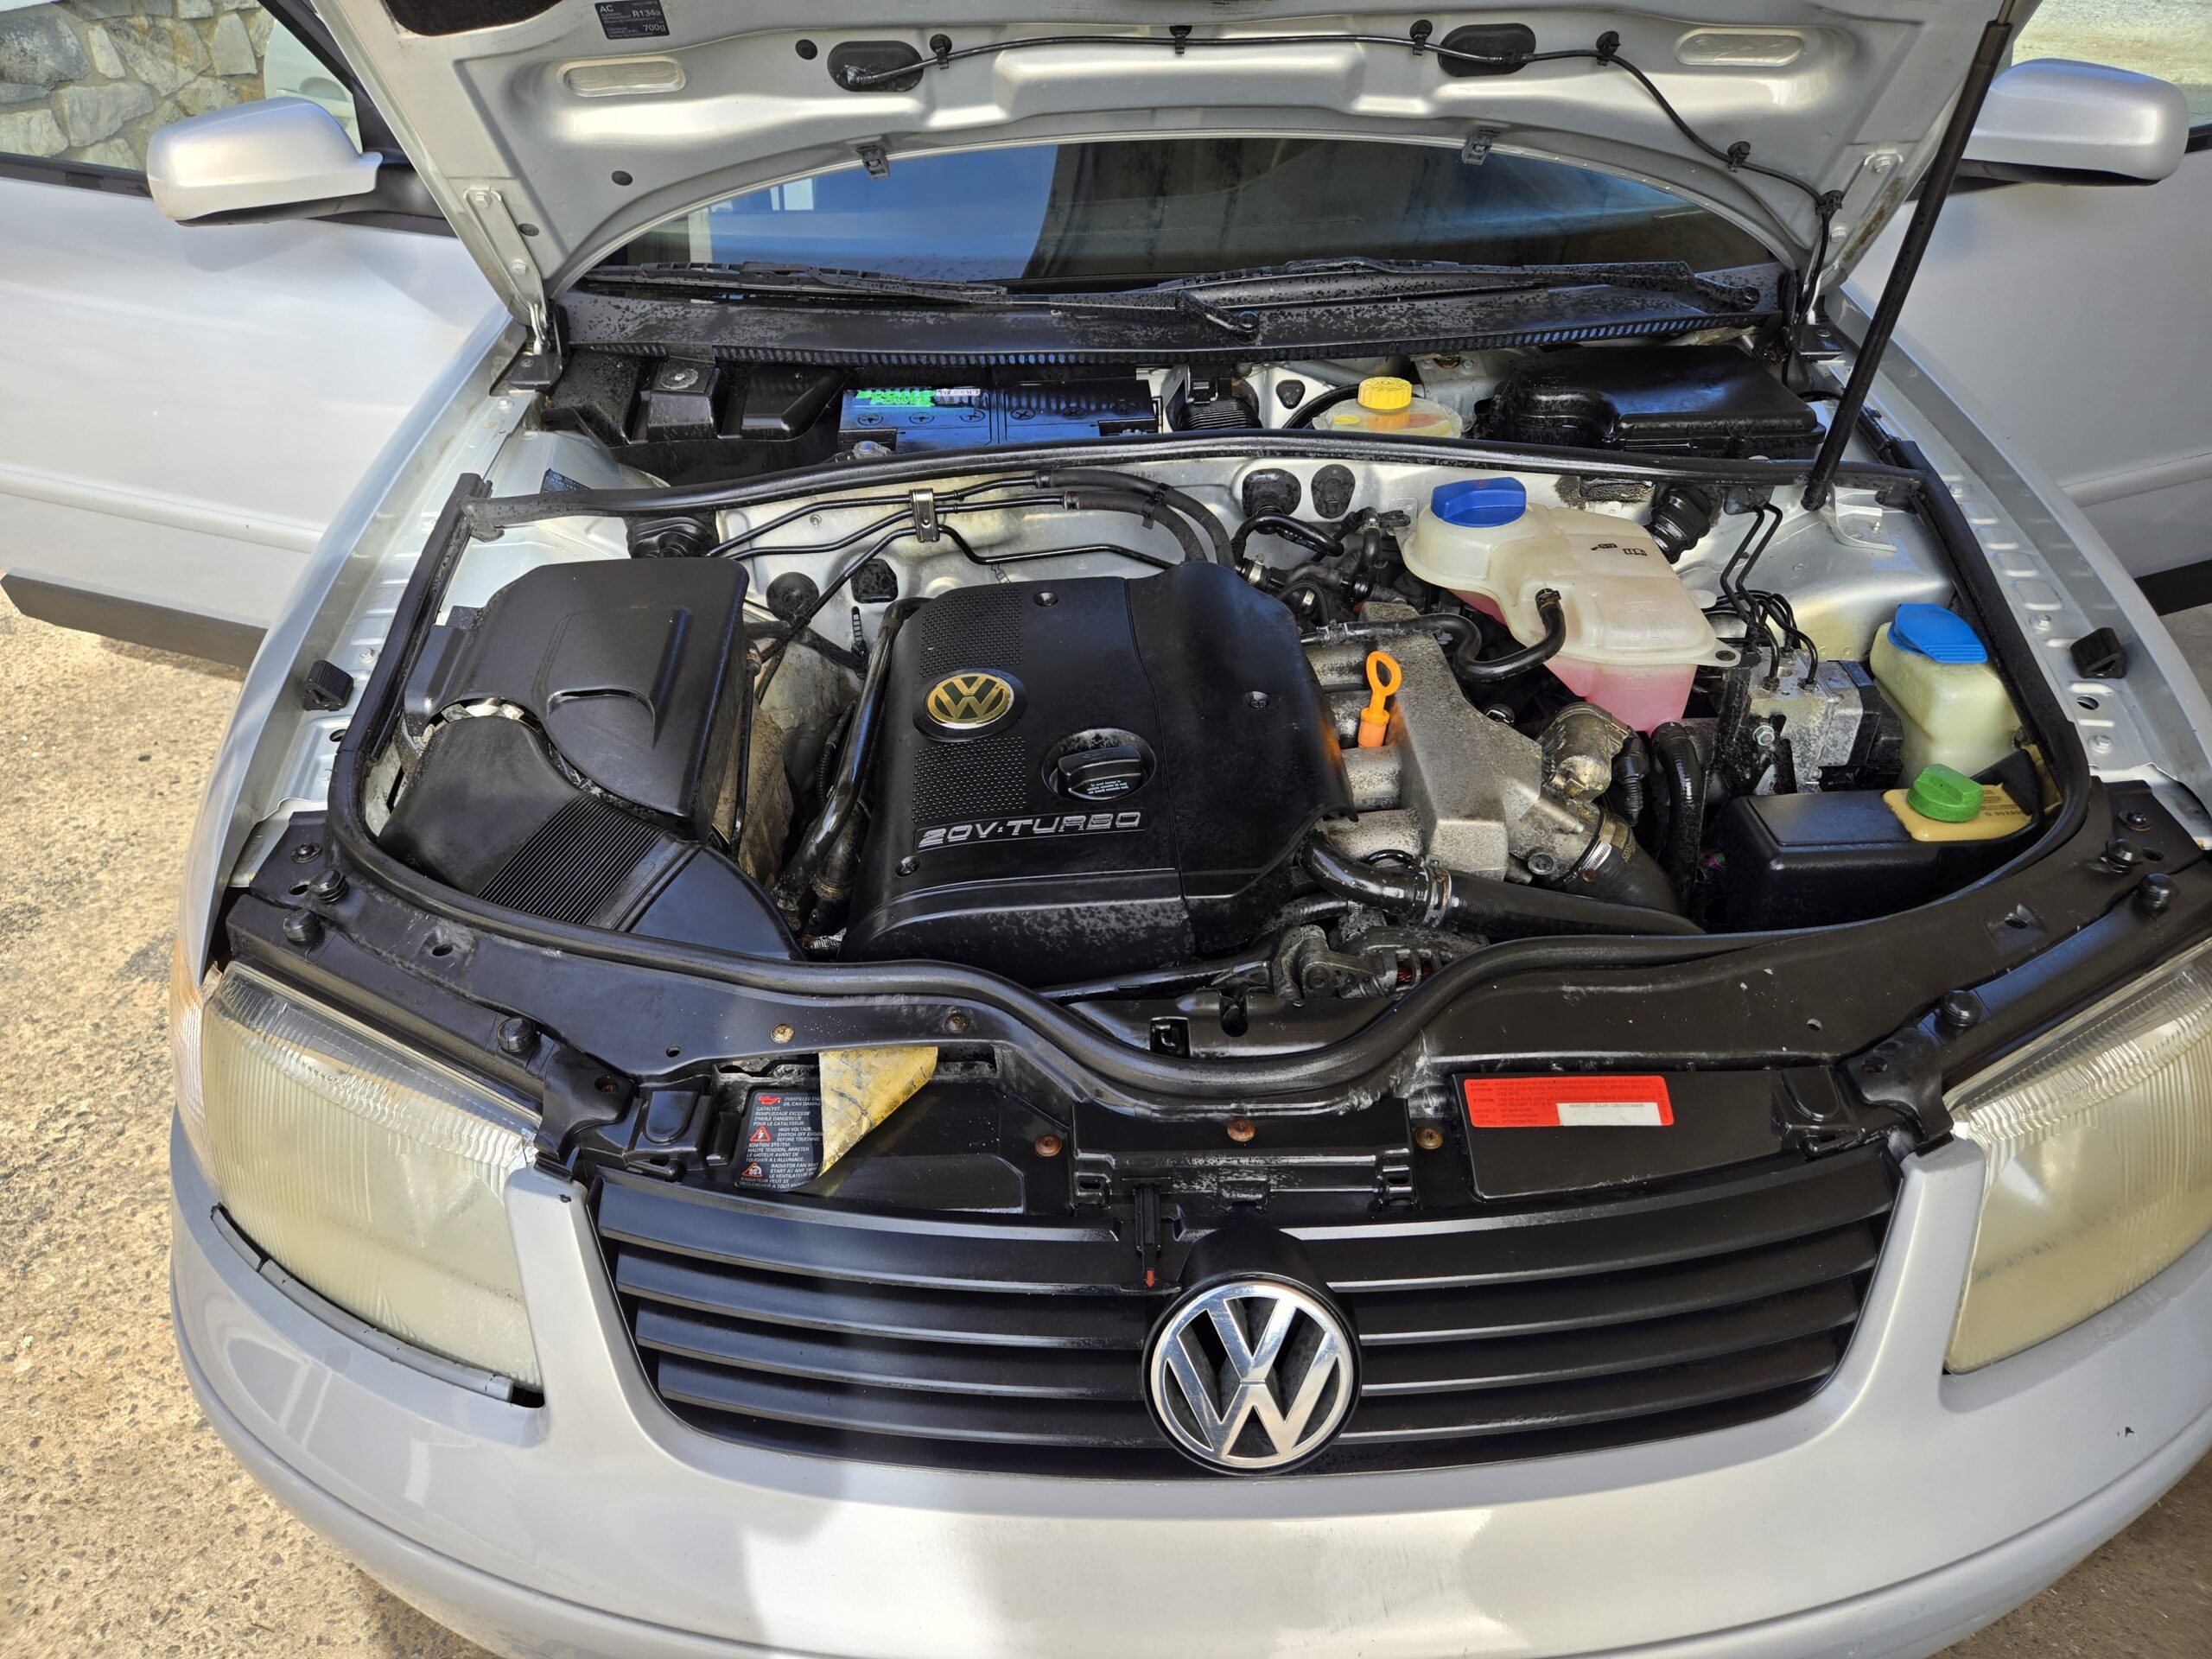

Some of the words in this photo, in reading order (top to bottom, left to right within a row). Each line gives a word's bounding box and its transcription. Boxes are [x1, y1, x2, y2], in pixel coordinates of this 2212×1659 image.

[600, 4, 614, 13] AC
[632, 9, 662, 19] R134a
[642, 24, 666, 33] 700g
